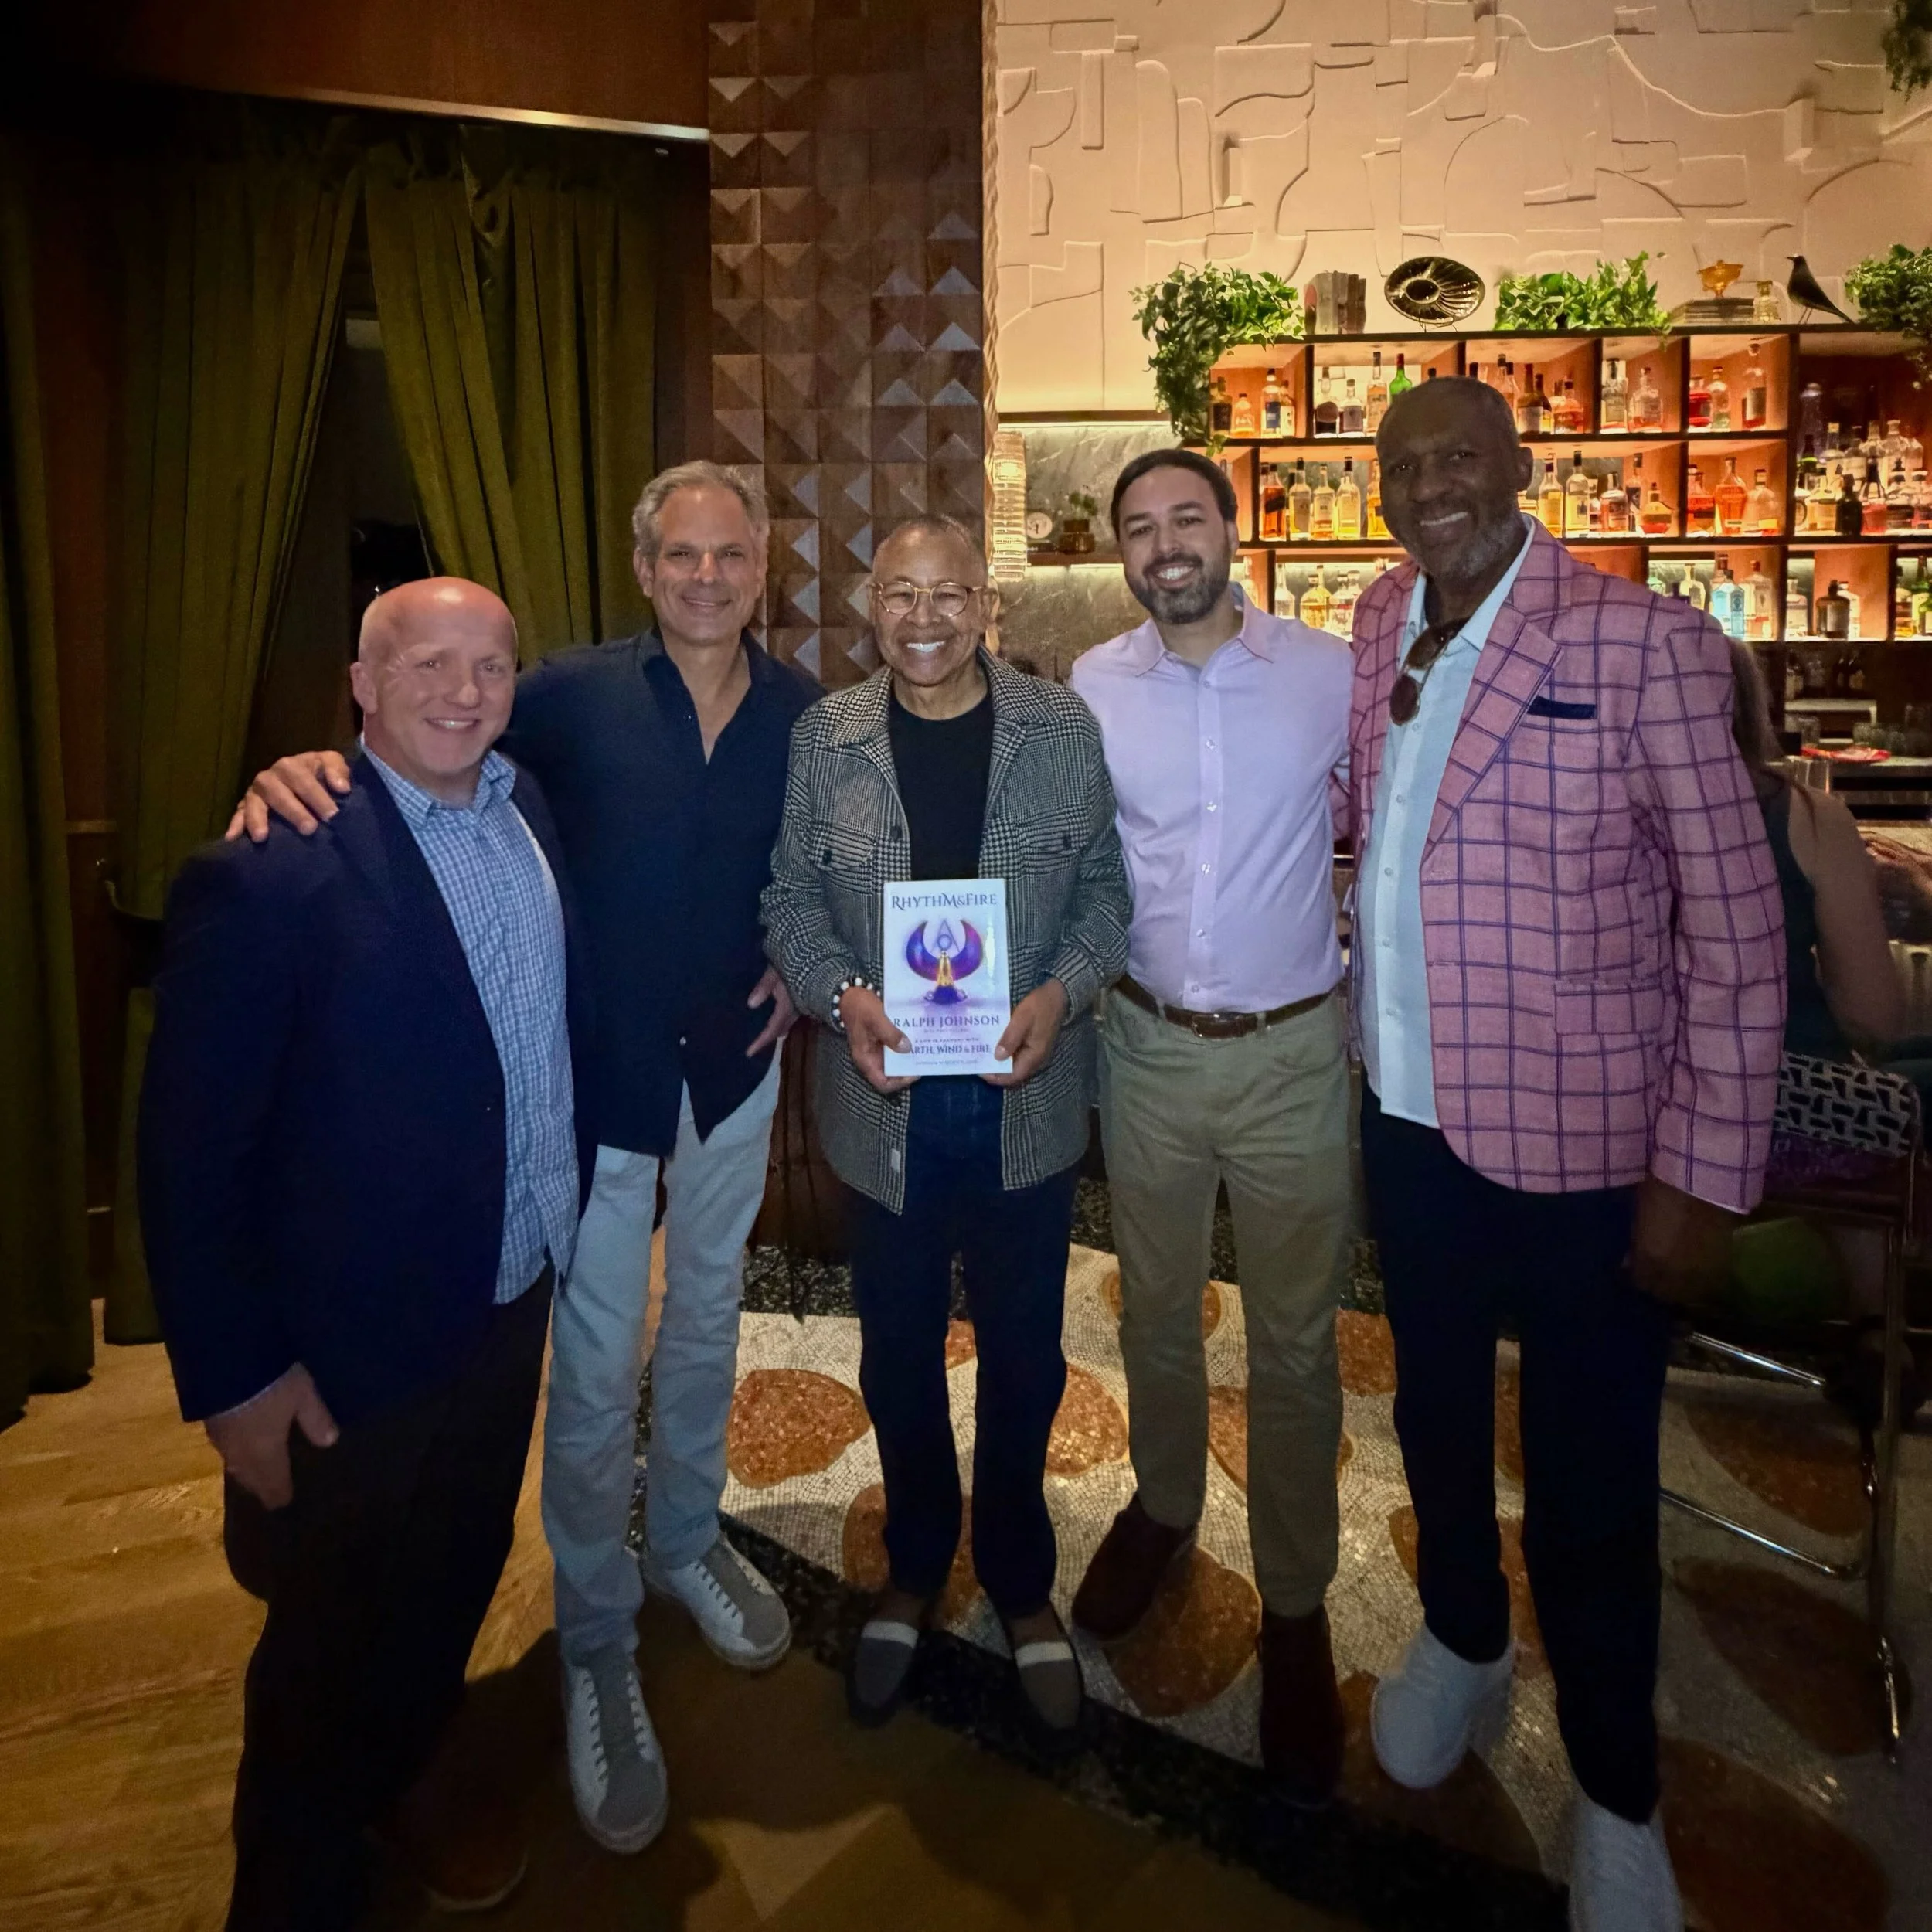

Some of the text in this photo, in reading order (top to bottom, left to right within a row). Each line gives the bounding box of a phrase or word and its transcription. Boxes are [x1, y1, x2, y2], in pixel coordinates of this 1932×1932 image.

[893, 1015, 999, 1028] RALPH JOHNSON
[937, 1044, 963, 1054] WIND
[971, 1043, 991, 1053] FIRE
